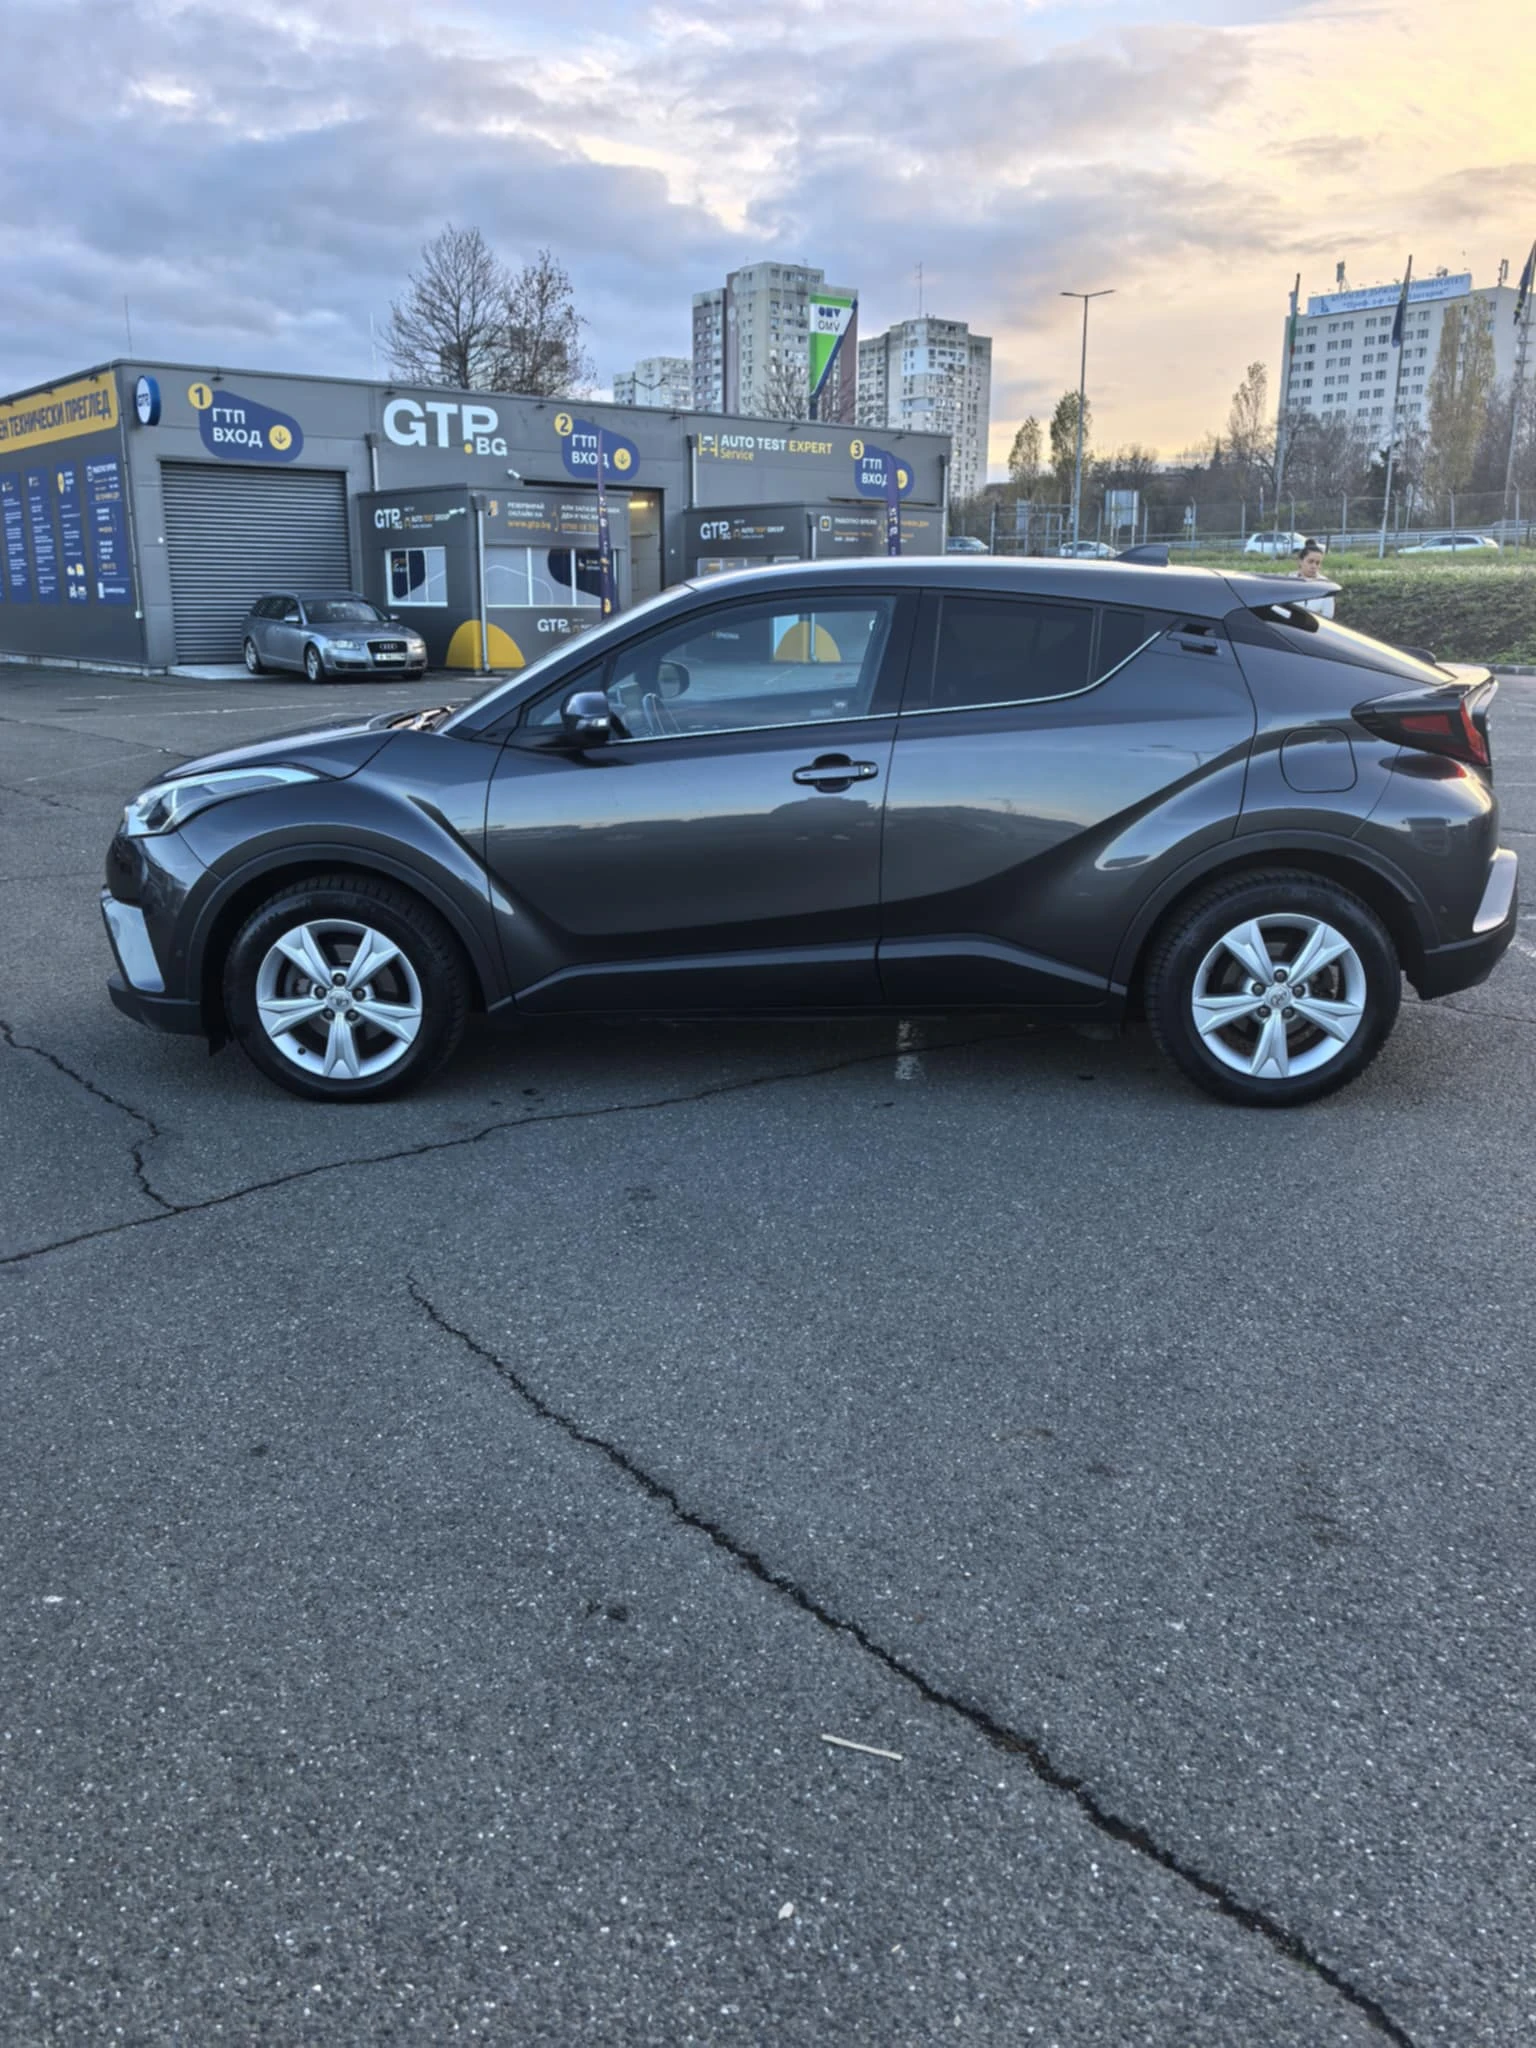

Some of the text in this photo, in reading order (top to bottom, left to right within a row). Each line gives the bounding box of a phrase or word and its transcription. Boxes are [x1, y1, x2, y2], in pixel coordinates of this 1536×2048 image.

[818, 319, 840, 332] OMV
[194, 386, 204, 407] 1
[9, 403, 63, 437] ТЕХНИЧЕСКИ
[64, 389, 111, 425] ПРЕГЛЕД
[212, 407, 246, 425] ГТП
[558, 415, 569, 433] 2
[212, 427, 263, 449] ВХОД
[571, 433, 598, 449] ГТП
[720, 434, 833, 455] AUTO TEST EXPERT
[720, 447, 754, 461] Service
[854, 442, 861, 457] 3
[862, 457, 883, 470] ГТП
[374, 508, 401, 529] GTP
[700, 521, 729, 540] GTP
[537, 618, 568, 632] GTP
